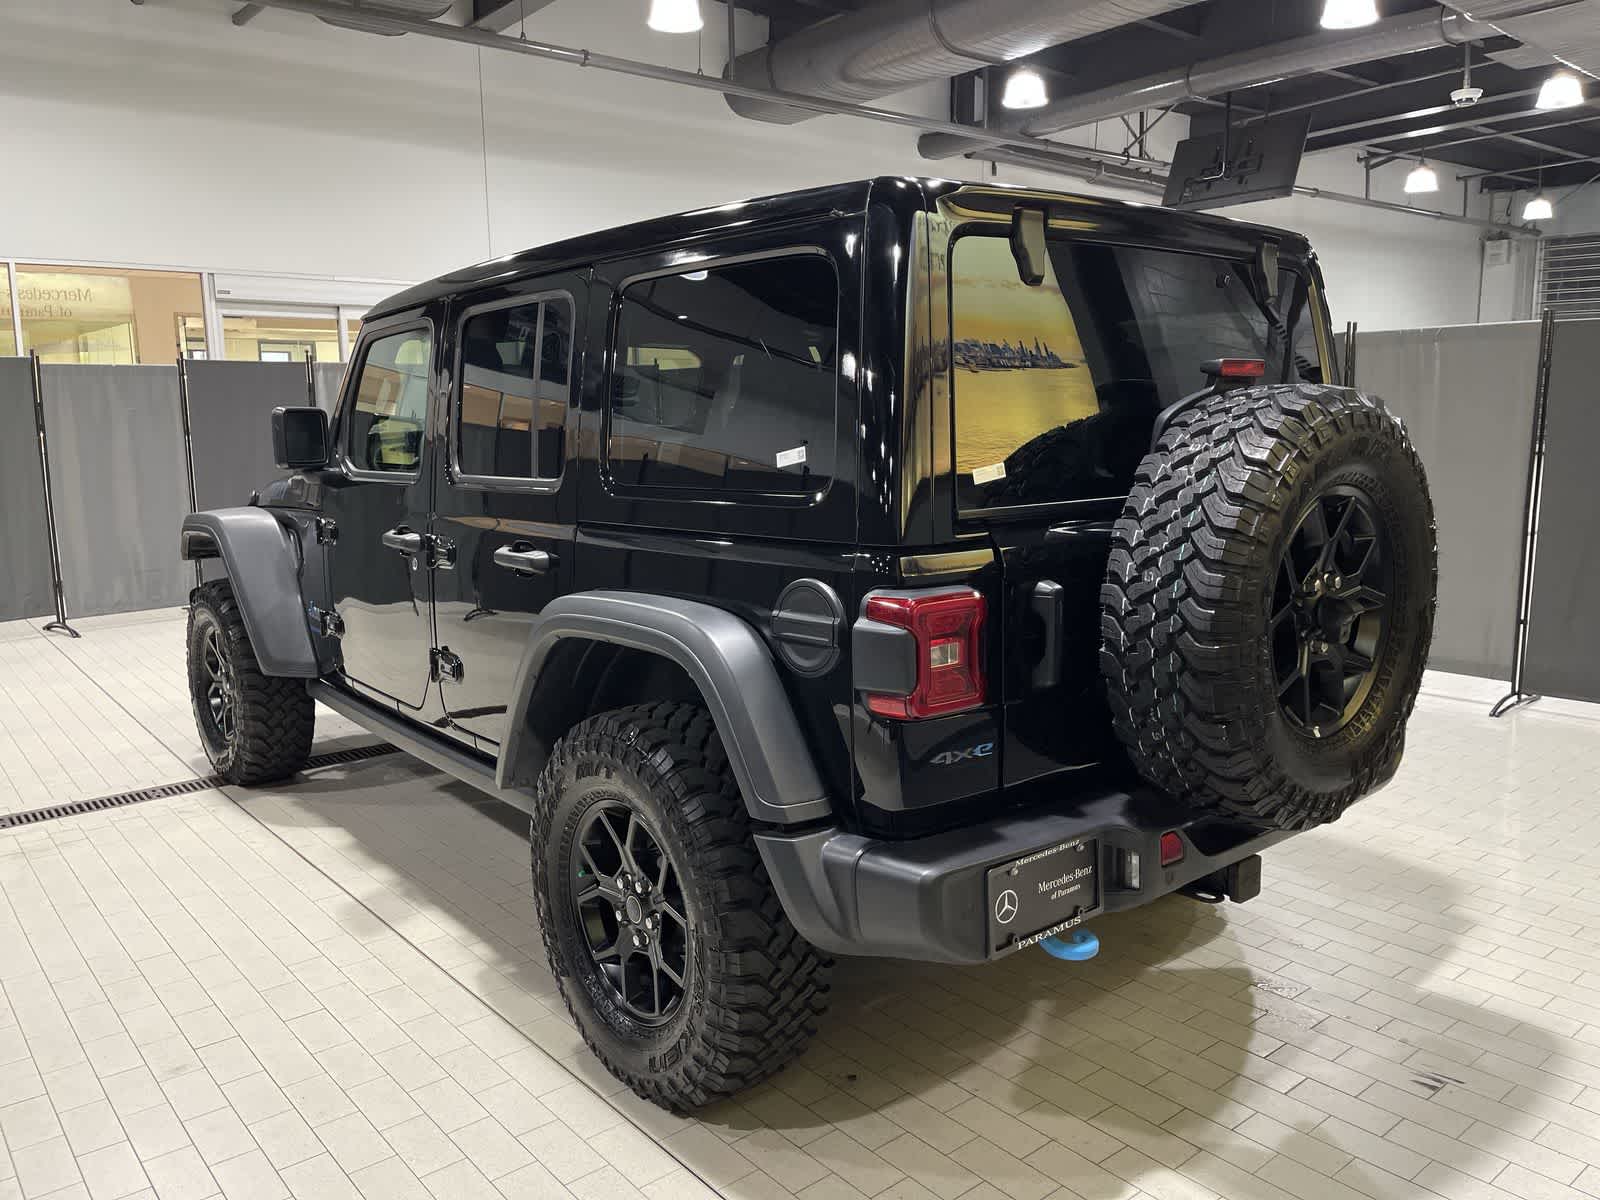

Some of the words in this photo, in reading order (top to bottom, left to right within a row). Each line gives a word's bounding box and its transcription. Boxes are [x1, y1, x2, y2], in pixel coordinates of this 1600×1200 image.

[1015, 839, 1080, 866] Mercedes-Benz
[1038, 865, 1092, 894] Mercedes-Benz
[1050, 890, 1058, 901] of
[1058, 883, 1081, 898] Paramus
[1018, 915, 1082, 949] PARAMUS
